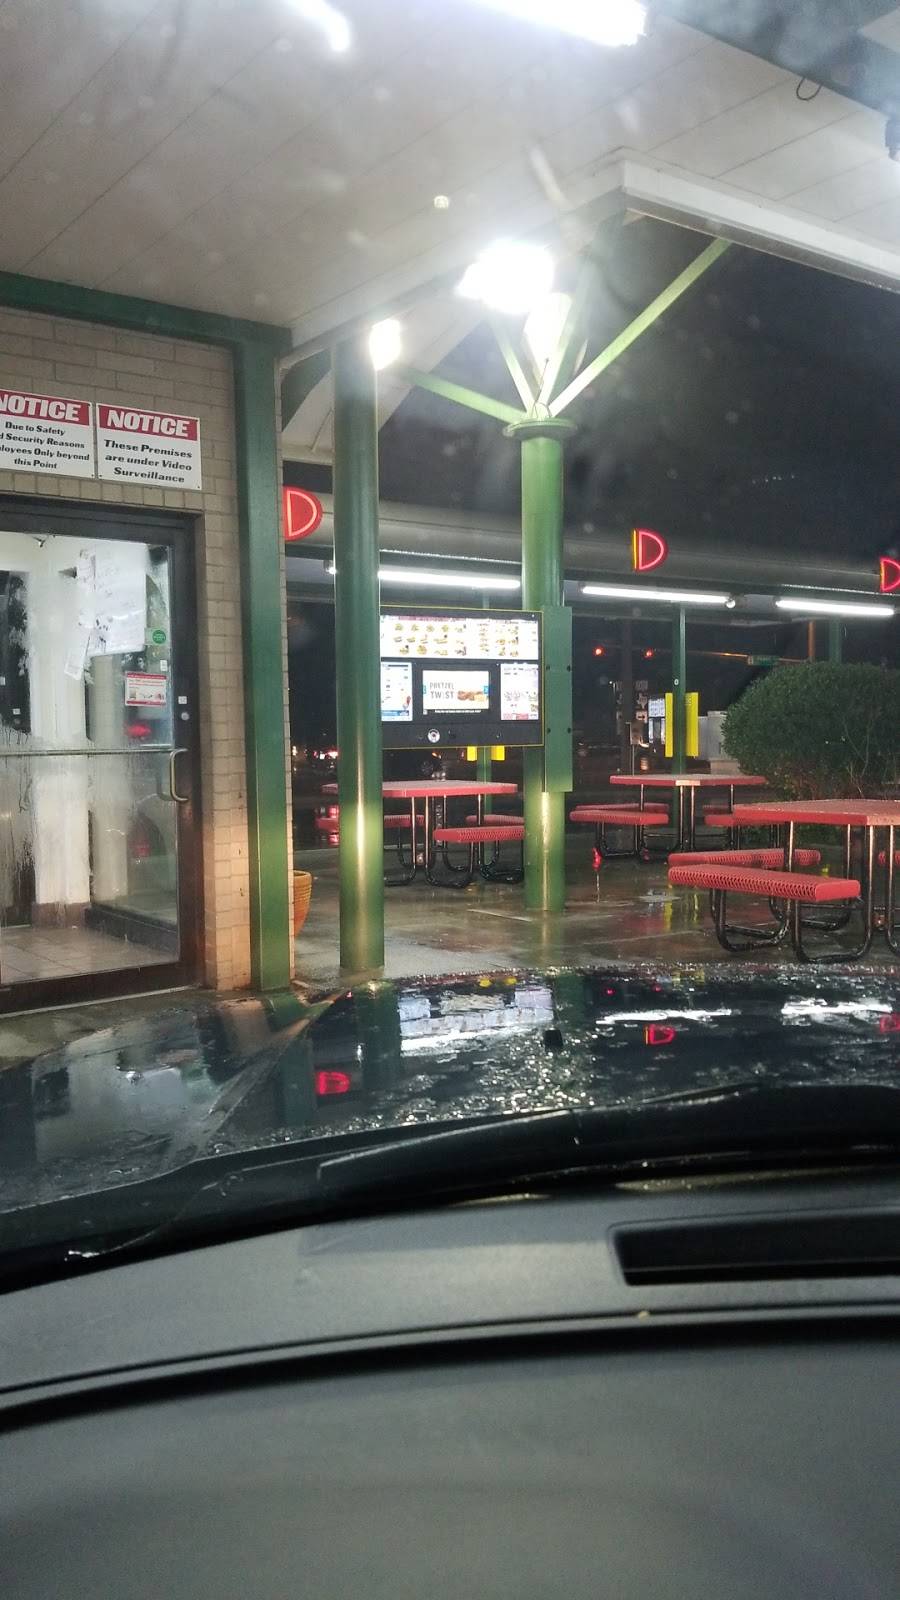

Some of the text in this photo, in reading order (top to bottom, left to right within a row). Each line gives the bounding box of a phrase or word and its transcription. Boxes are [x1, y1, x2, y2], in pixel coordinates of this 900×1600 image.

[5, 421, 24, 430] Due
[36, 425, 65, 436] Safety
[107, 409, 190, 437] NOTICE
[6, 433, 45, 445] Security
[47, 438, 85, 449] Reasons
[104, 439, 192, 458] These Premises
[0, 444, 90, 461] loyees Only beyond
[14, 457, 58, 468] this Point
[105, 454, 192, 471] are under Video
[114, 467, 185, 483] Surveillance
